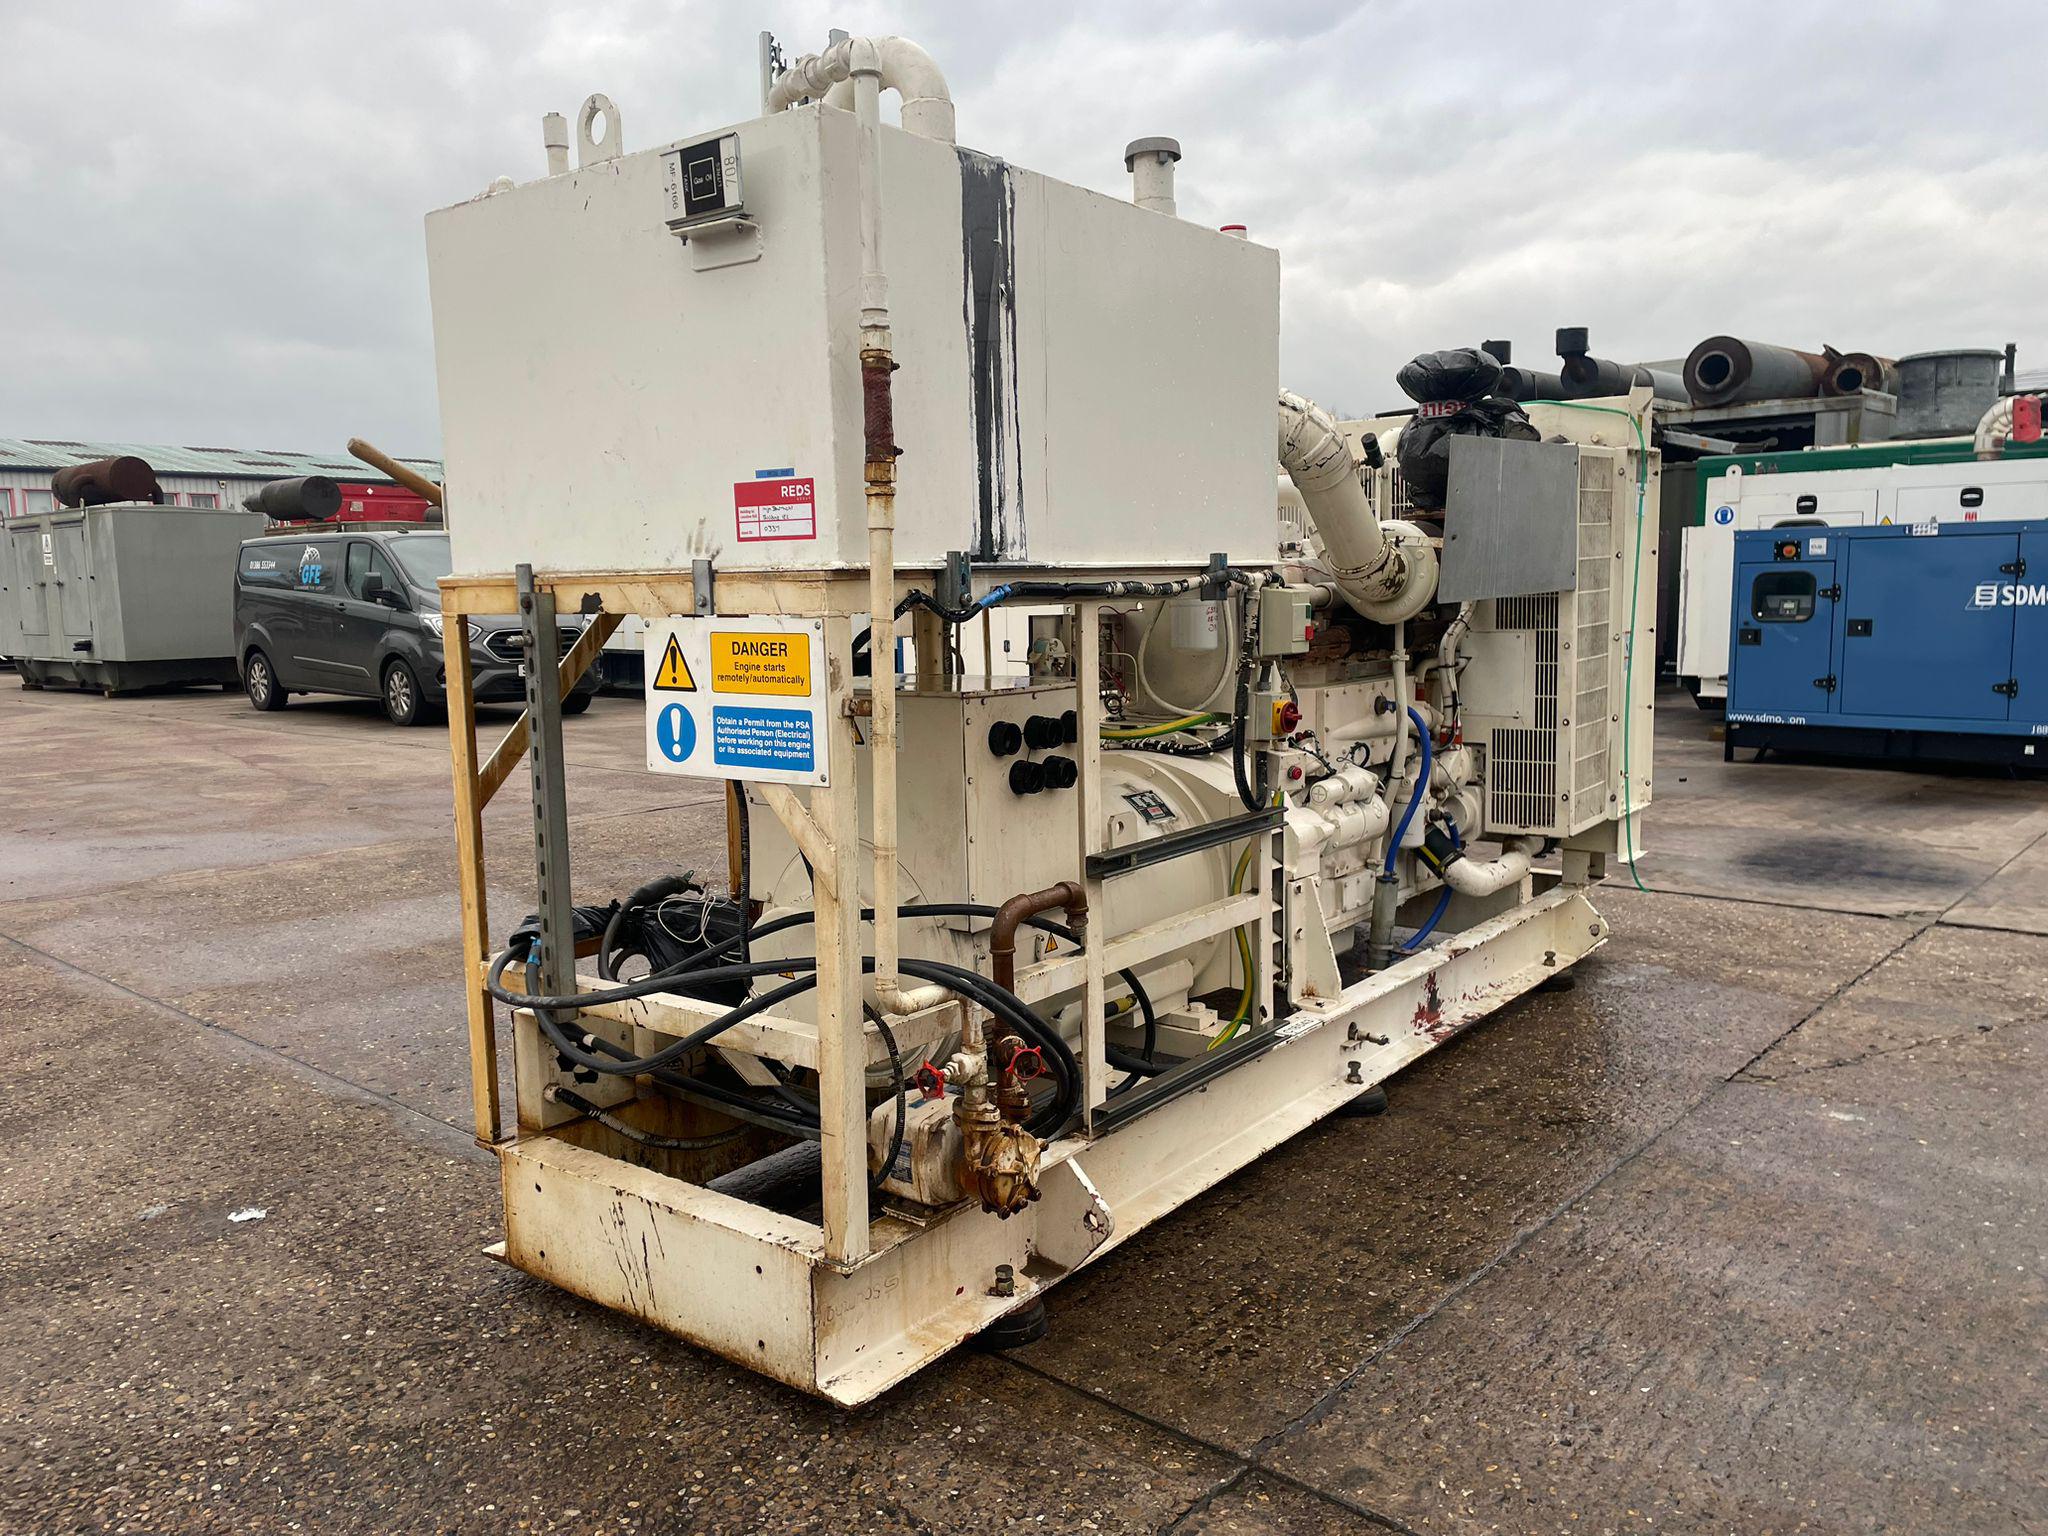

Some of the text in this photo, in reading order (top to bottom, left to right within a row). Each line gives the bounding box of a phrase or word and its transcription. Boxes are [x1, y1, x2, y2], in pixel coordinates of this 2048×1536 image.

[724, 157, 736, 187] 708
[781, 484, 811, 497] REDS
[302, 564, 321, 584] GFE
[2001, 584, 2048, 607] SDM
[731, 641, 788, 656] DANGER
[734, 661, 786, 673] Engine starts
[717, 673, 805, 686] remotely/automatically
[716, 716, 737, 726] Obtain
[743, 718, 765, 728] Permit
[766, 719, 781, 729] from
[782, 720, 794, 730] the
[795, 721, 810, 730] PSA
[1728, 712, 1806, 726] www.sdmo.om
[717, 726, 811, 741] Authorised Person (Electrical)
[717, 735, 737, 745] before
[738, 738, 763, 748] working
[774, 740, 787, 749] this
[787, 741, 811, 751] engine
[727, 746, 736, 754] its
[737, 747, 772, 757] associated
[773, 749, 811, 760] equipment
